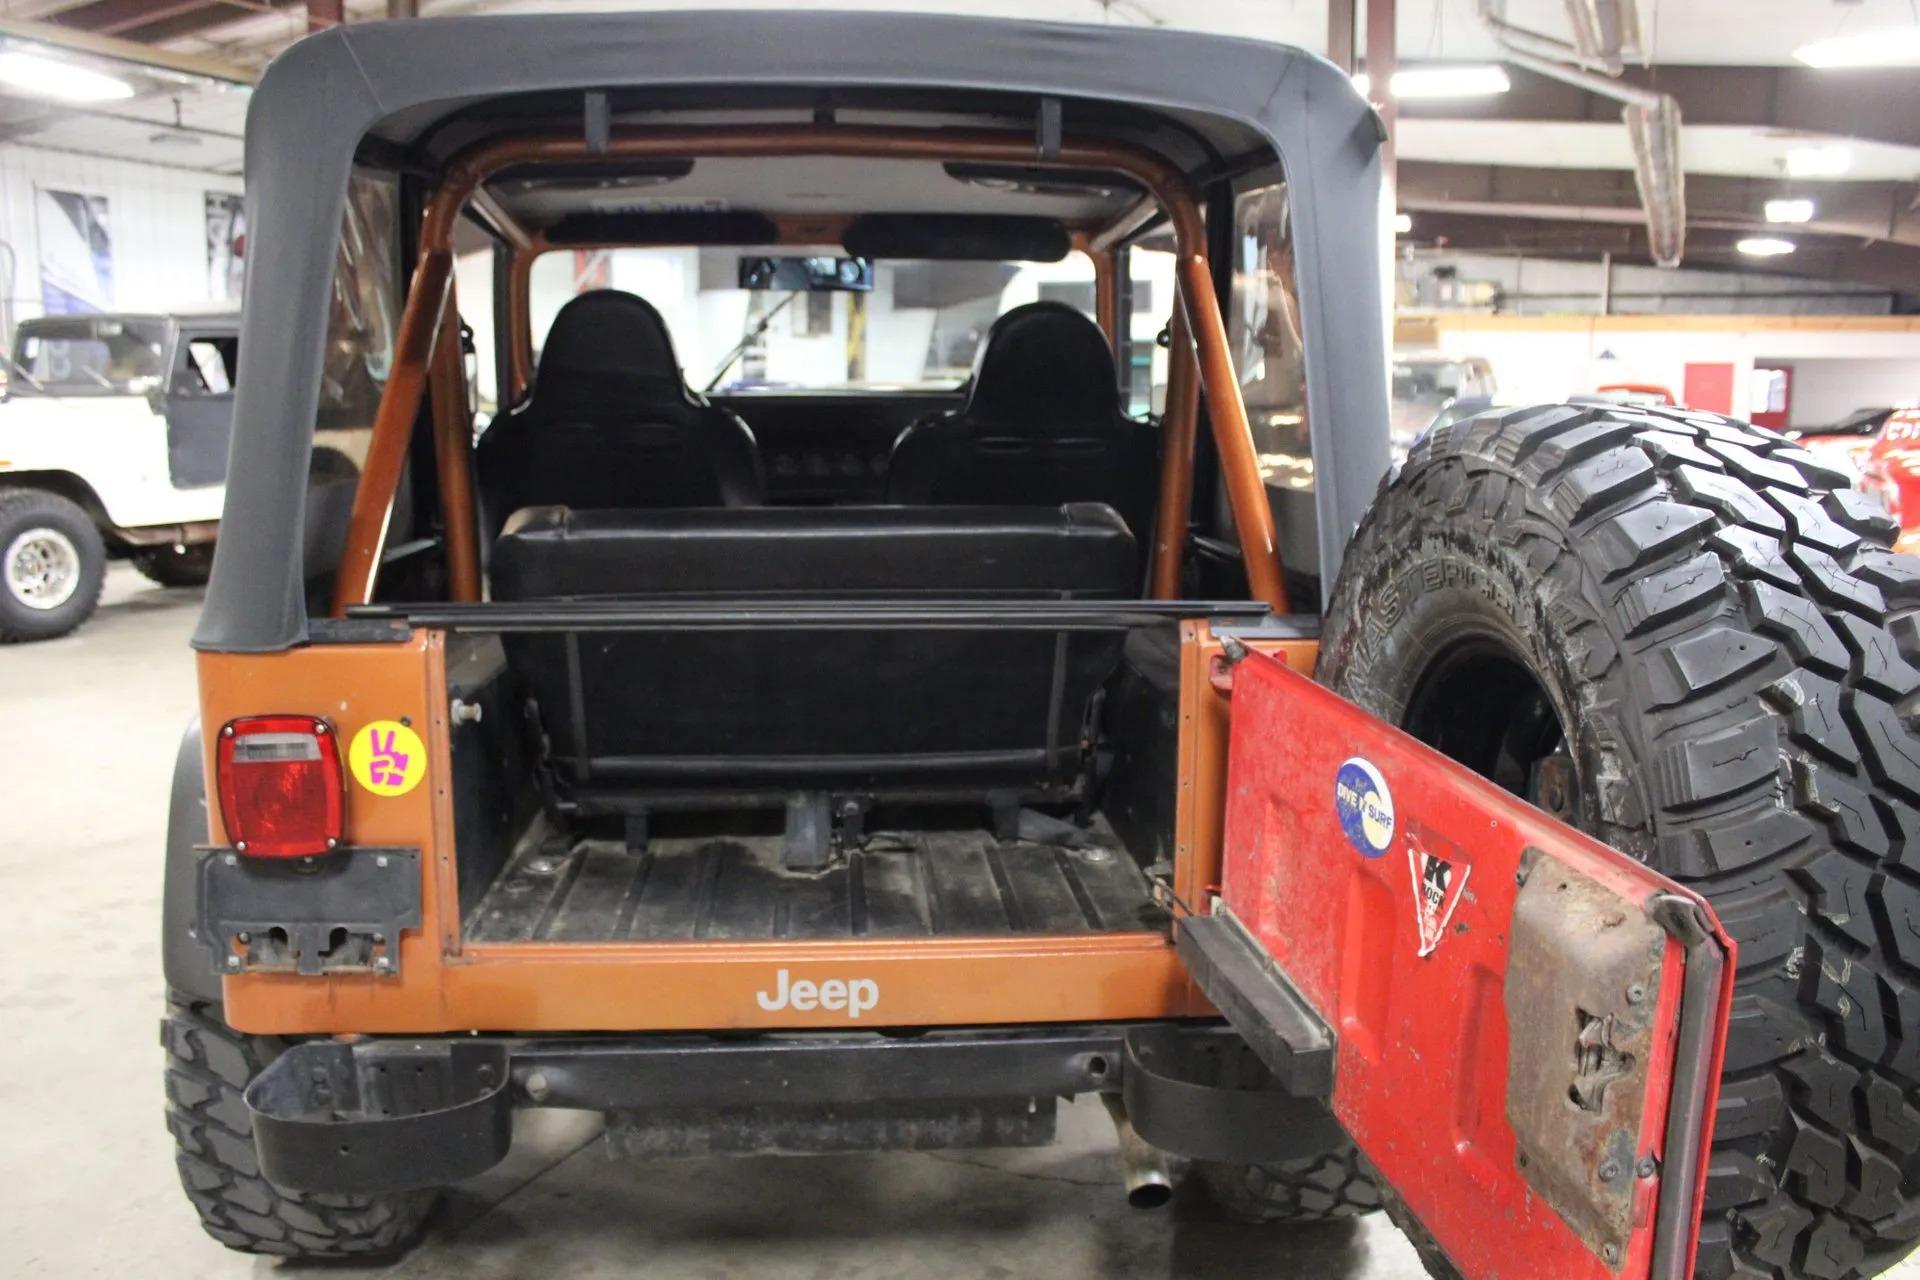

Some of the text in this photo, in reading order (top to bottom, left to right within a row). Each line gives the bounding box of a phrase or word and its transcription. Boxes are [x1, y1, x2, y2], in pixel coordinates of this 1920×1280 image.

[1337, 782, 1358, 807] DIVE
[1368, 804, 1393, 829] SURF
[1423, 855, 1452, 894] K
[756, 969, 879, 1018] Jeep
